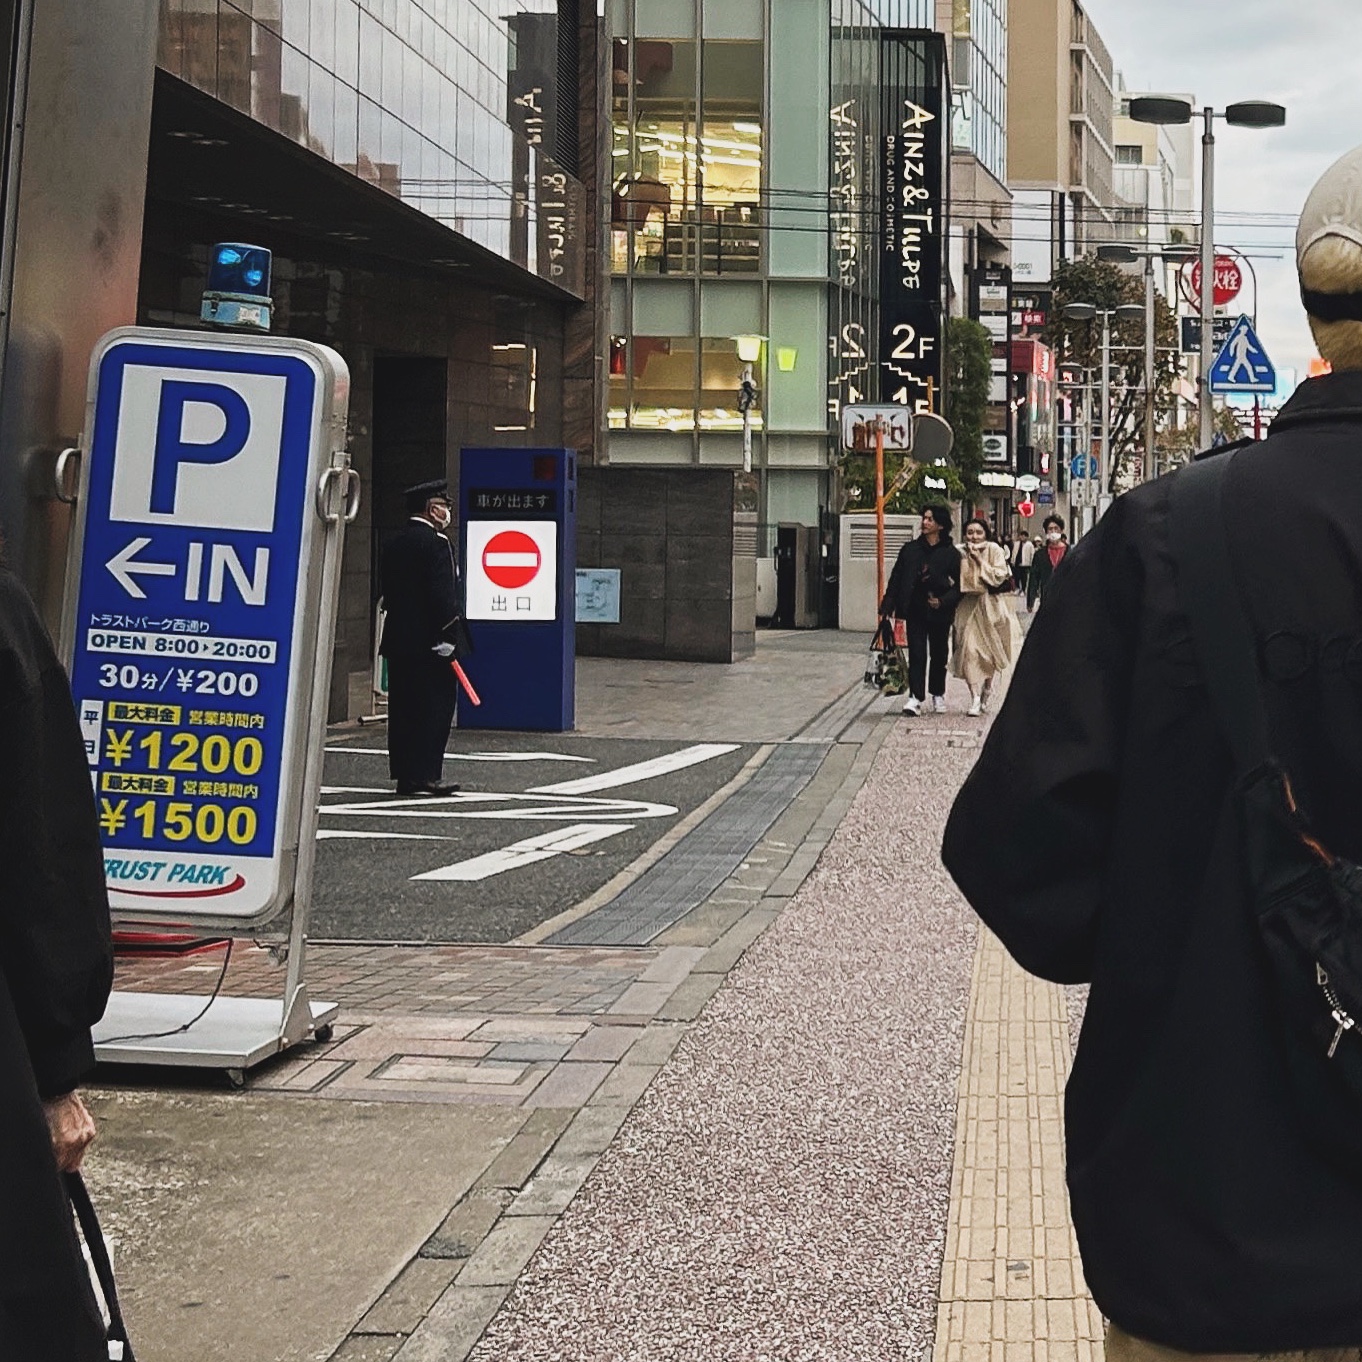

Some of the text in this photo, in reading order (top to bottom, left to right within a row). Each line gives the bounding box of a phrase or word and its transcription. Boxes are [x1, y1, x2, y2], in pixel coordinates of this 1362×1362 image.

[891, 324, 935, 359] 2F
[149, 379, 251, 515] P
[477, 494, 549, 508] 車が出ます
[185, 542, 270, 606] IN
[91, 634, 271, 660] OPEN 8:00 20:00
[114, 705, 265, 729] 最大料金 営業時間内
[108, 776, 258, 799] 最大料金 営業時間内
[167, 863, 231, 885] PARK
